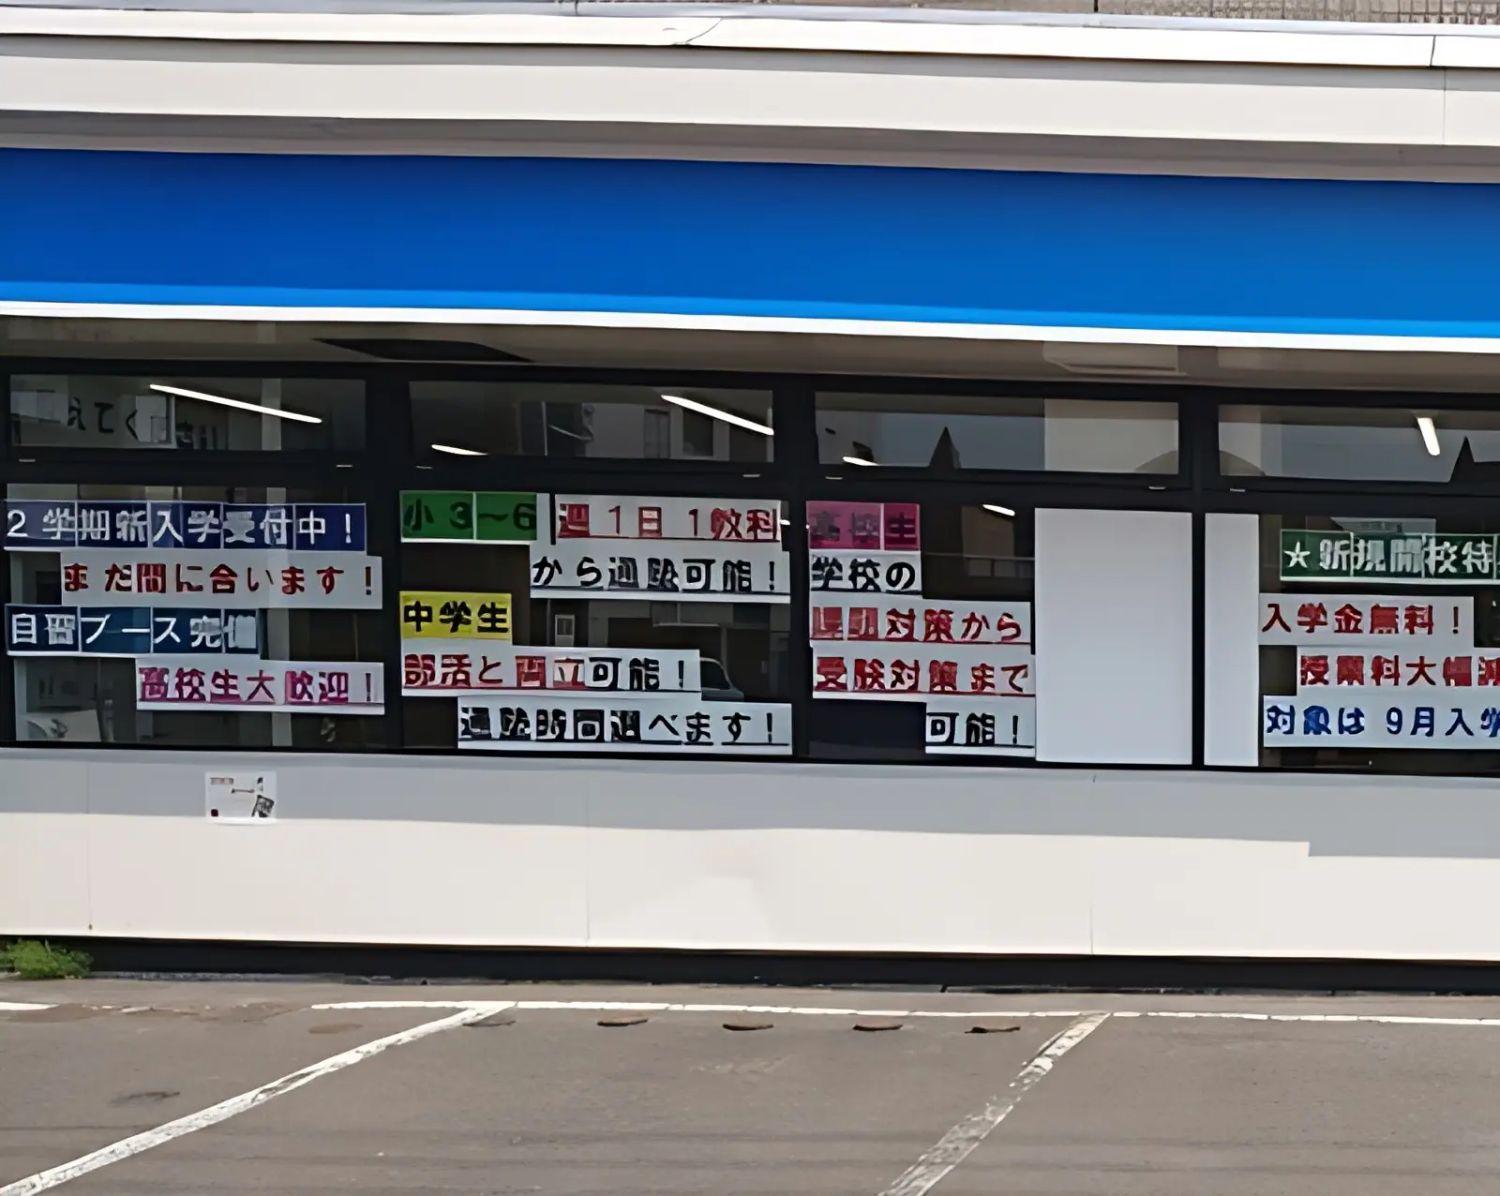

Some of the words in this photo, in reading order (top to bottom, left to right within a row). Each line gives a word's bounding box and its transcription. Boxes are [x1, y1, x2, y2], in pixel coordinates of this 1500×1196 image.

[811, 556, 917, 592] 学校の
[403, 600, 510, 633] 中学生
